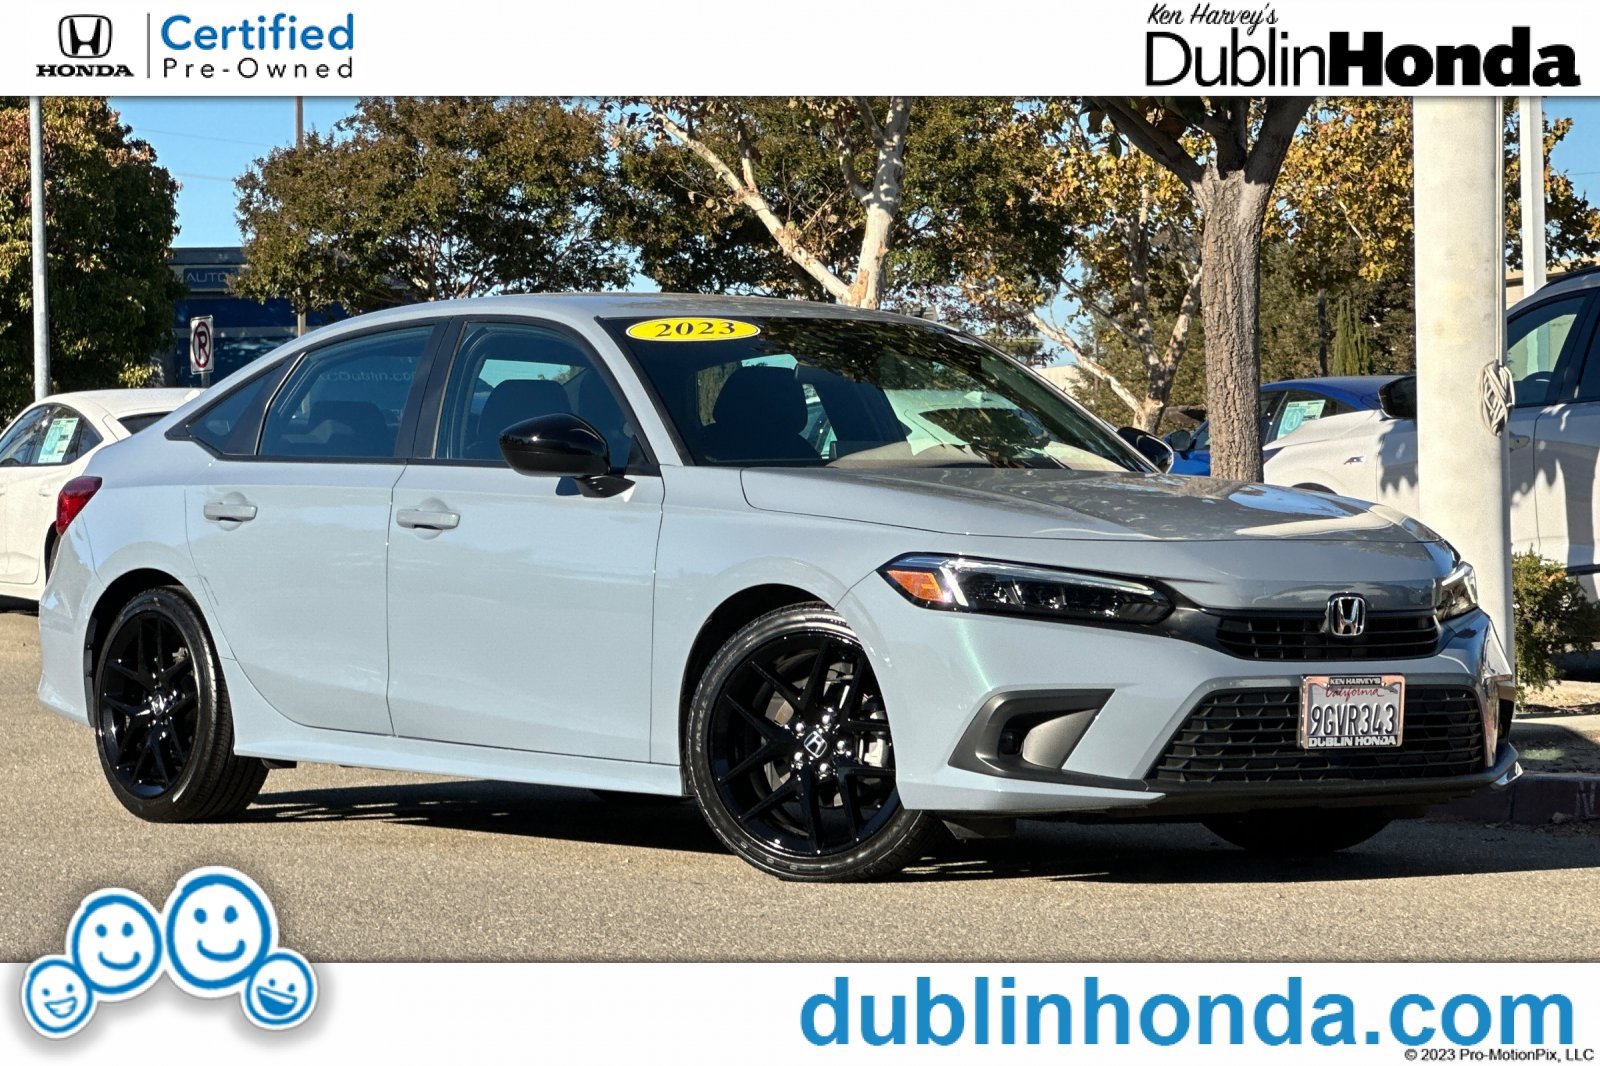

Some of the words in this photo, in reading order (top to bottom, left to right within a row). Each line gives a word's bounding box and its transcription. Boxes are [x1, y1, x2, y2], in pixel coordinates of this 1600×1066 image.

[655, 321, 735, 338] 2023
[1346, 677, 1381, 685] HARVEY'S
[1325, 686, 1385, 702] California
[1310, 702, 1396, 736] 9GVR343
[1308, 736, 1354, 747] DUBLIN
[1355, 735, 1397, 746] HONDA
